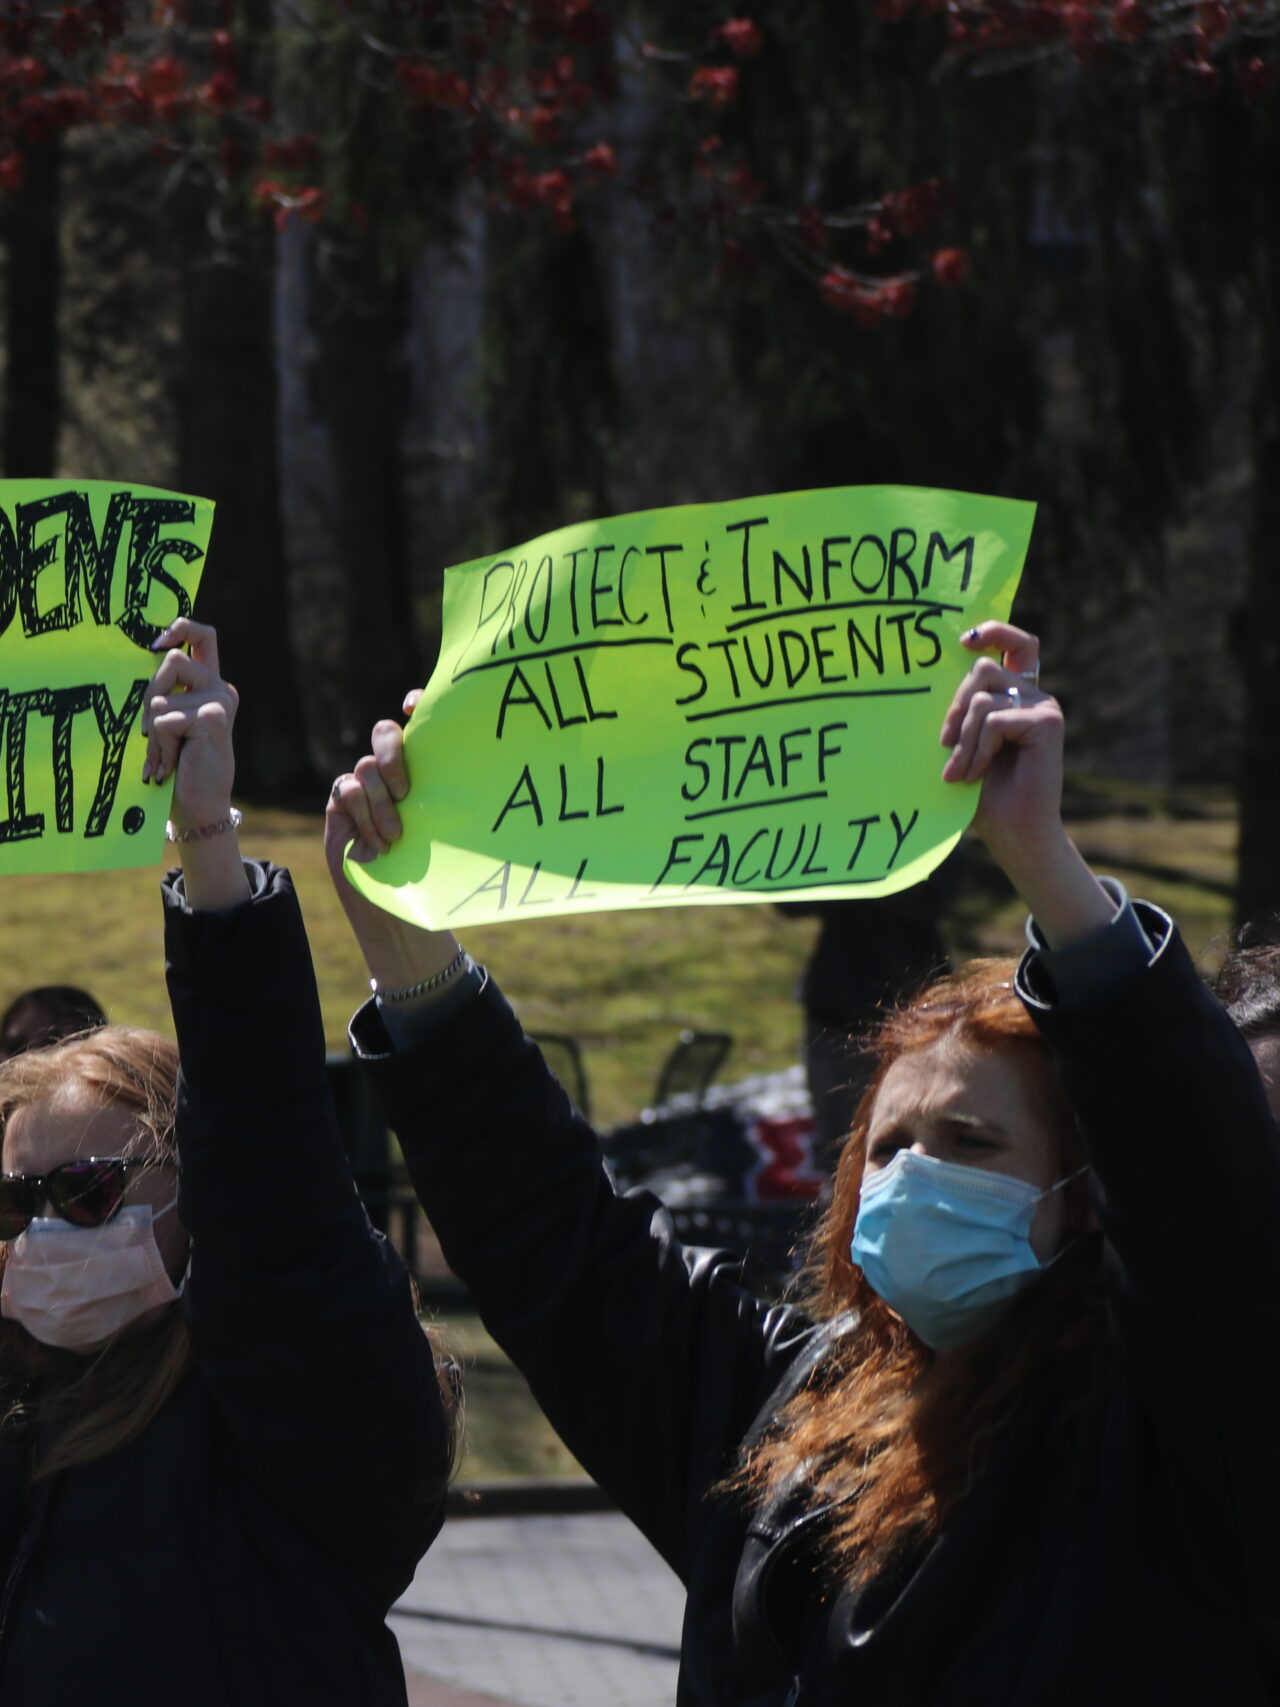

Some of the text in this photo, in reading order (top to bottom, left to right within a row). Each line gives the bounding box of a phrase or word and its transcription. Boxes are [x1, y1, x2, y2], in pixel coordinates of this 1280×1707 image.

[452, 544, 684, 675] PROTECT
[726, 516, 975, 611] INFORM
[495, 607, 943, 740] ALL STUDENTS
[492, 722, 848, 832] ALL STAFF
[447, 809, 919, 916] ALL FACULTY
